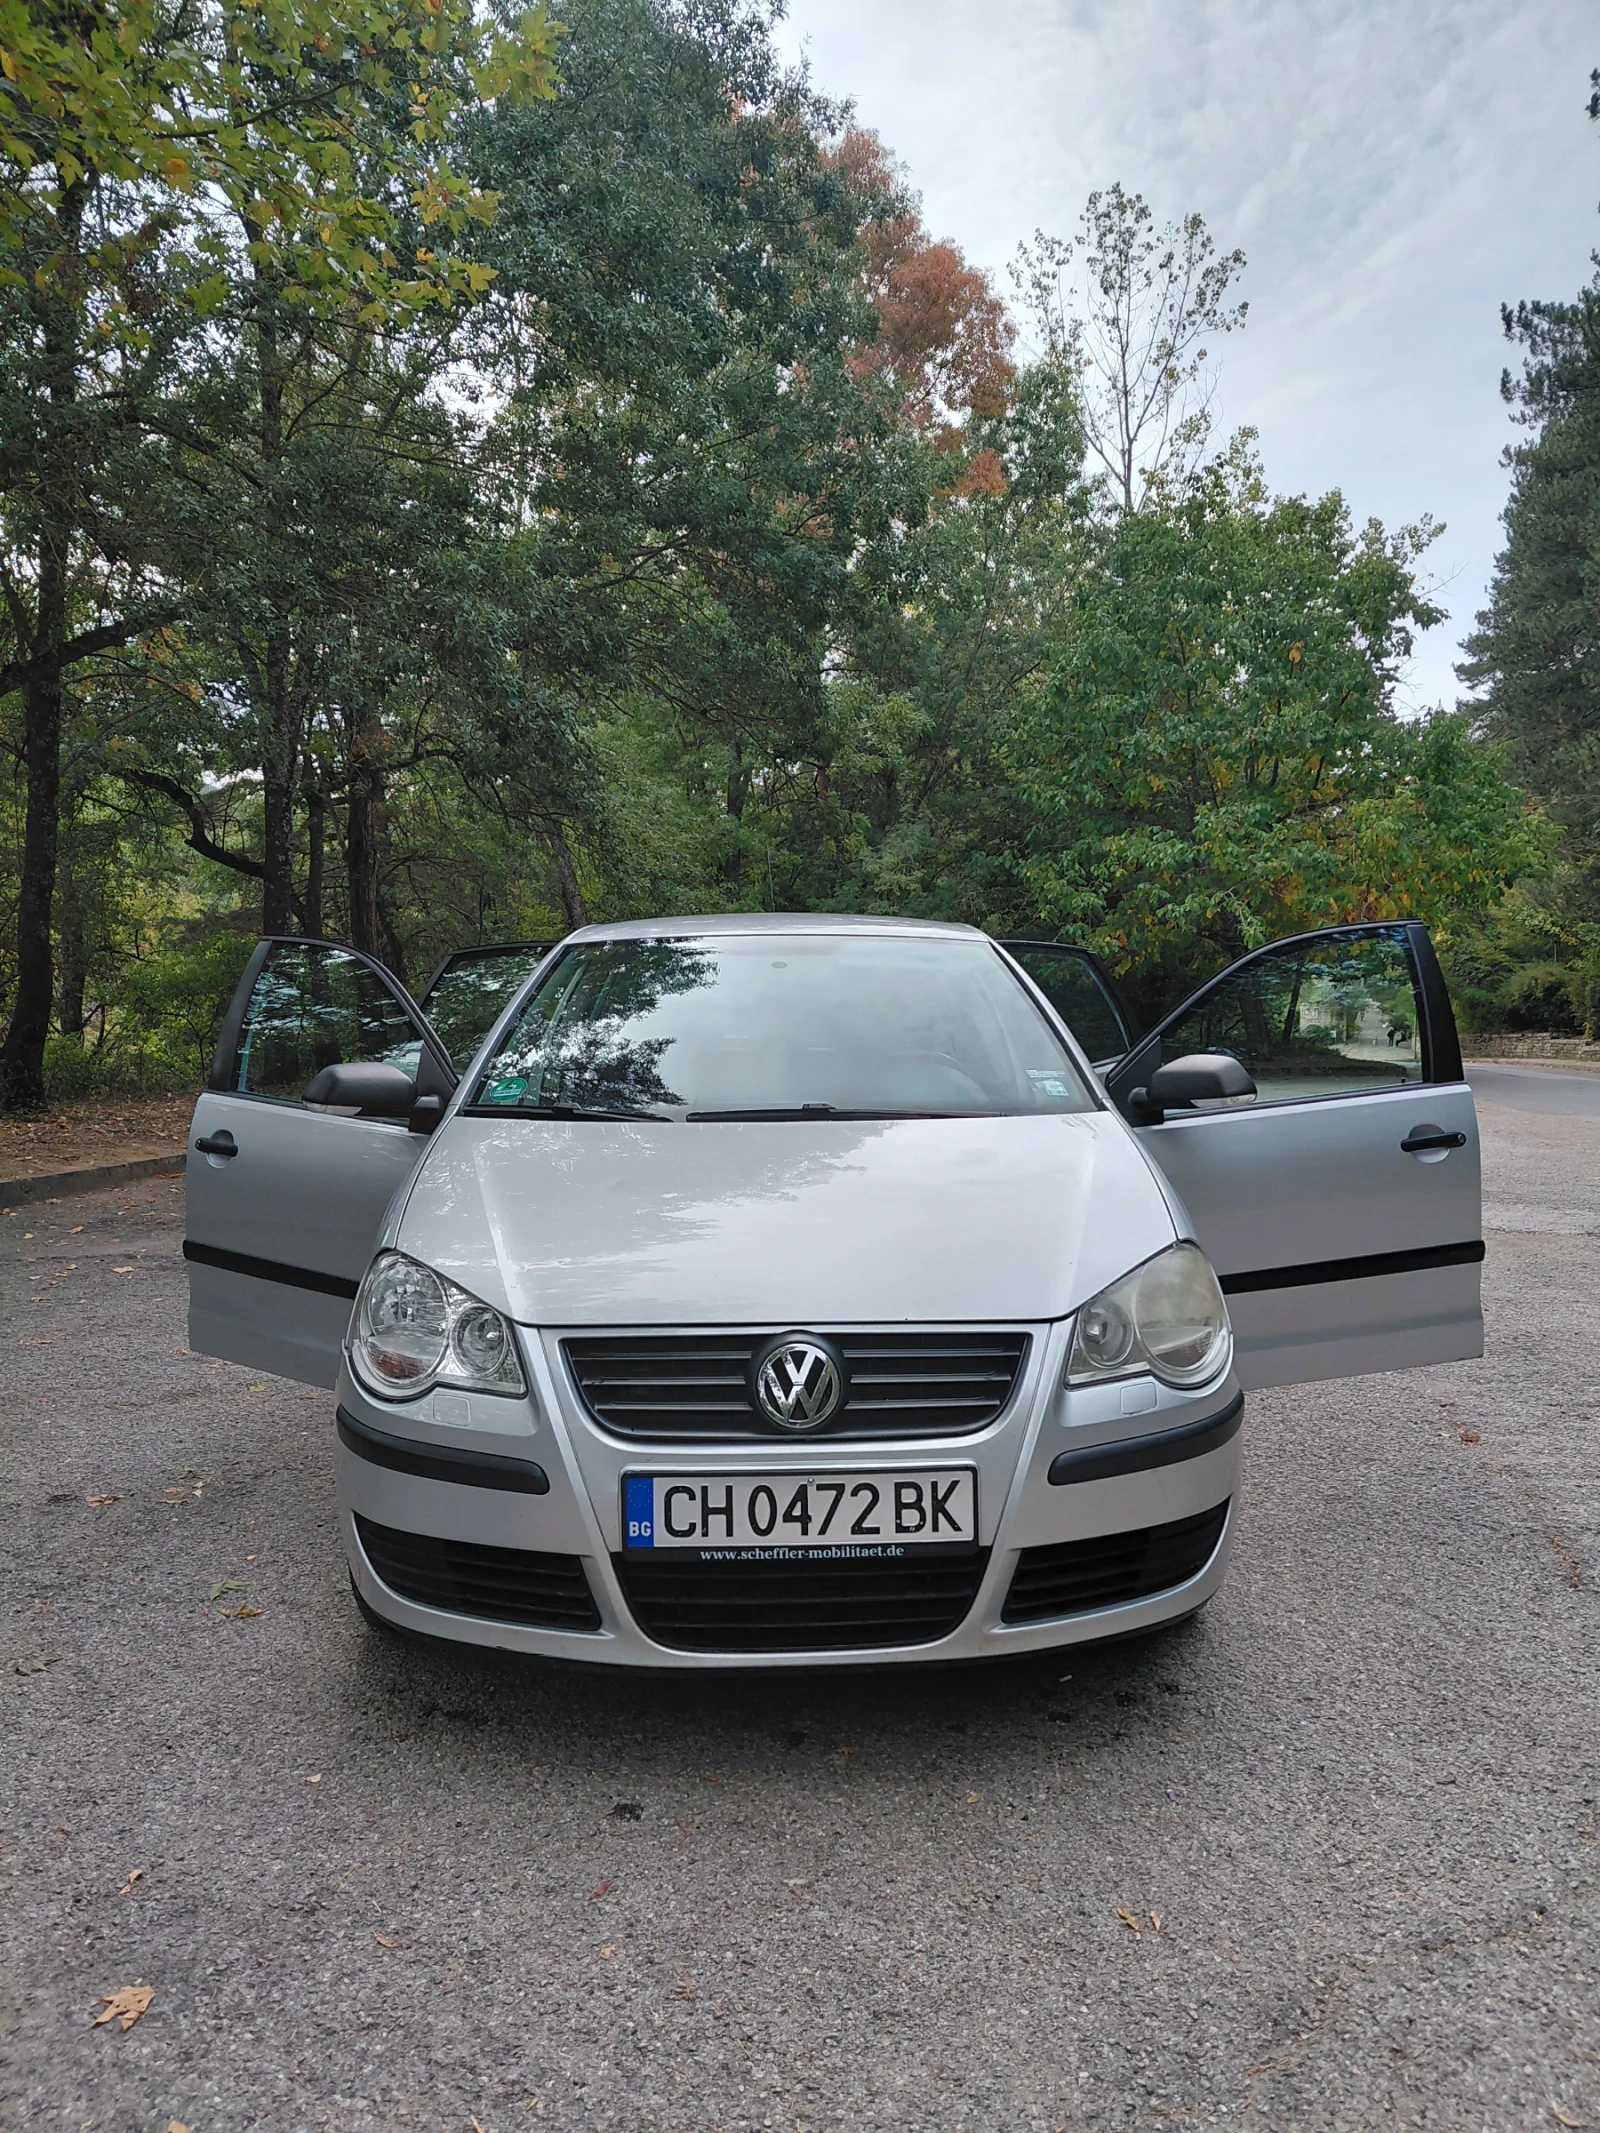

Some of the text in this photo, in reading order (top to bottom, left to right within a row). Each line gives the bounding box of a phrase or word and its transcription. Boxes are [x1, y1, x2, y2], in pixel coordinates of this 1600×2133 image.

[758, 1343, 840, 1429] VW
[629, 1521, 651, 1537] BG
[700, 1545, 905, 1560] www.scheffler-mobilitaet.de
